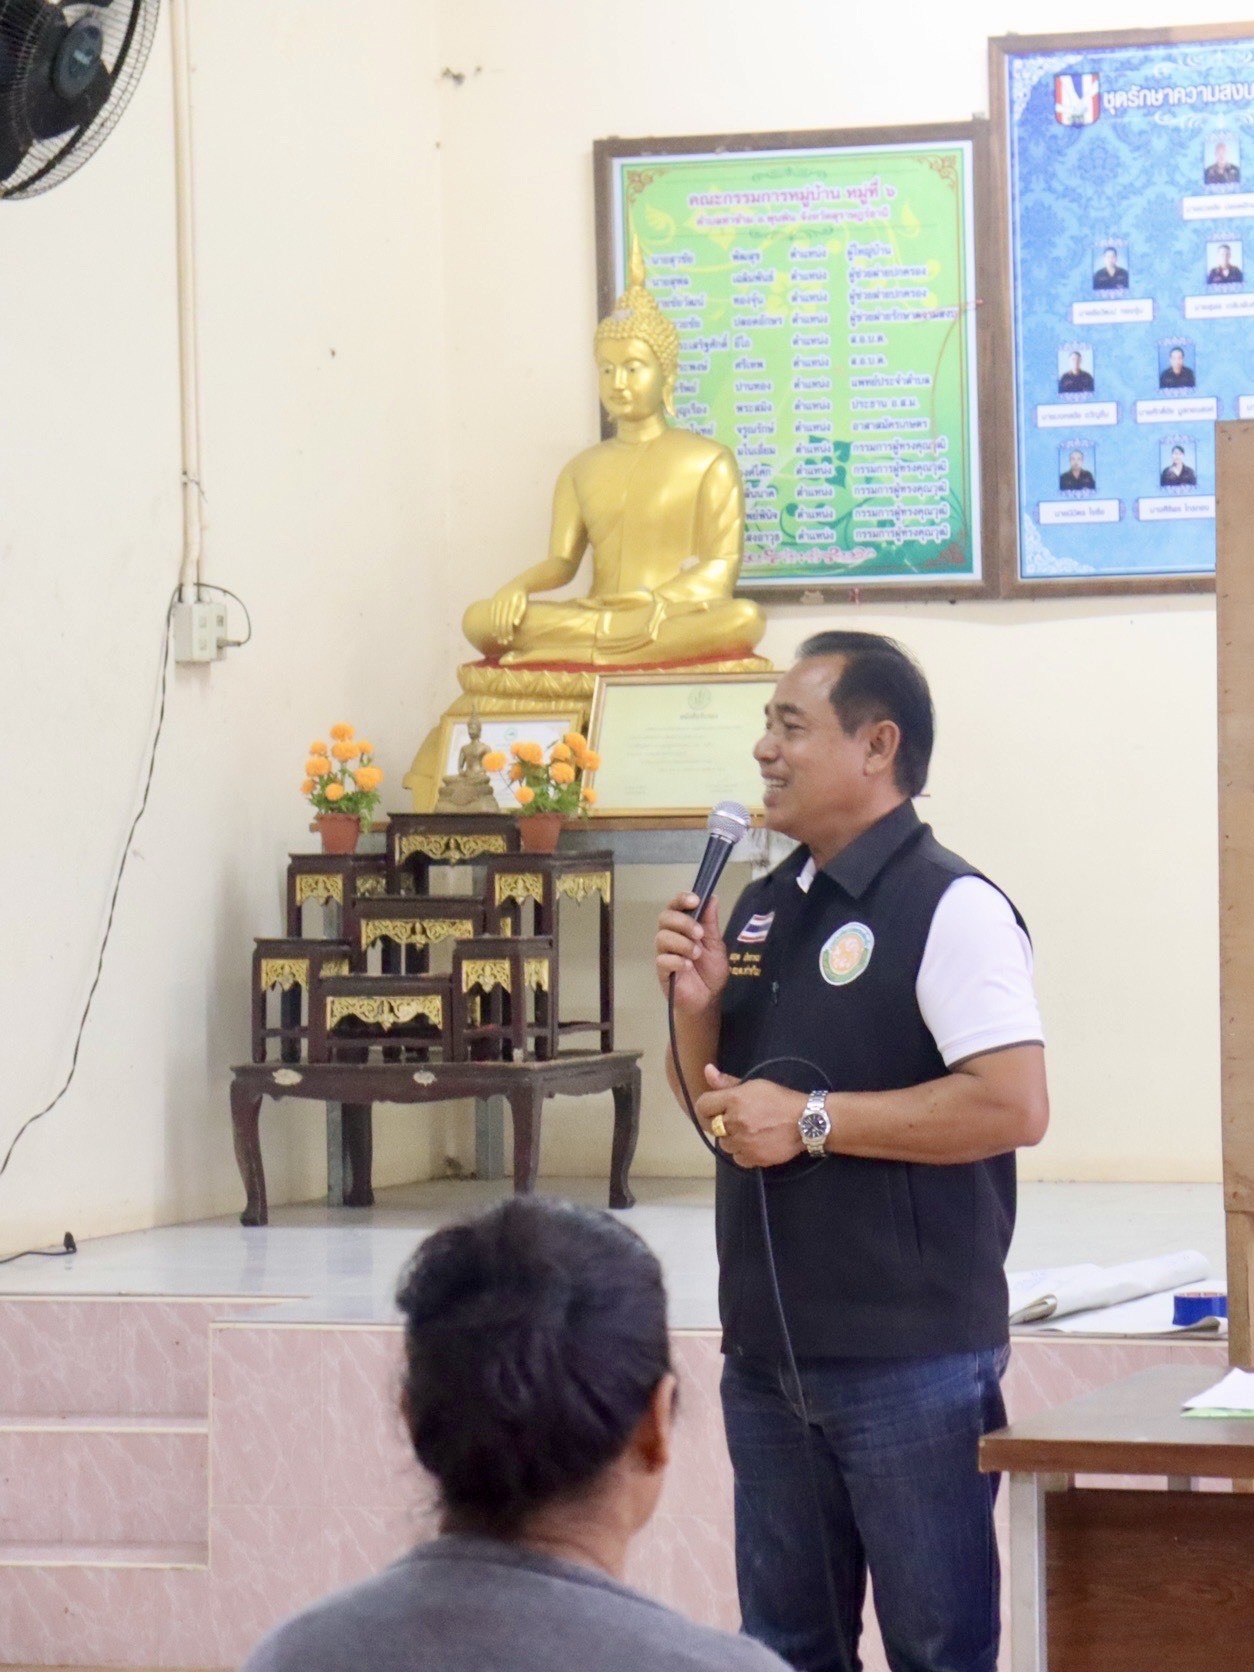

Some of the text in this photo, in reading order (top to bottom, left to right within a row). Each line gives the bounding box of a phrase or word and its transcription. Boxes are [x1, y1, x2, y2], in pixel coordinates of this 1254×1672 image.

[689, 185, 840, 207] คณะกรรมการหมู่บ้าน
[846, 180, 879, 205] หมู่ที่
